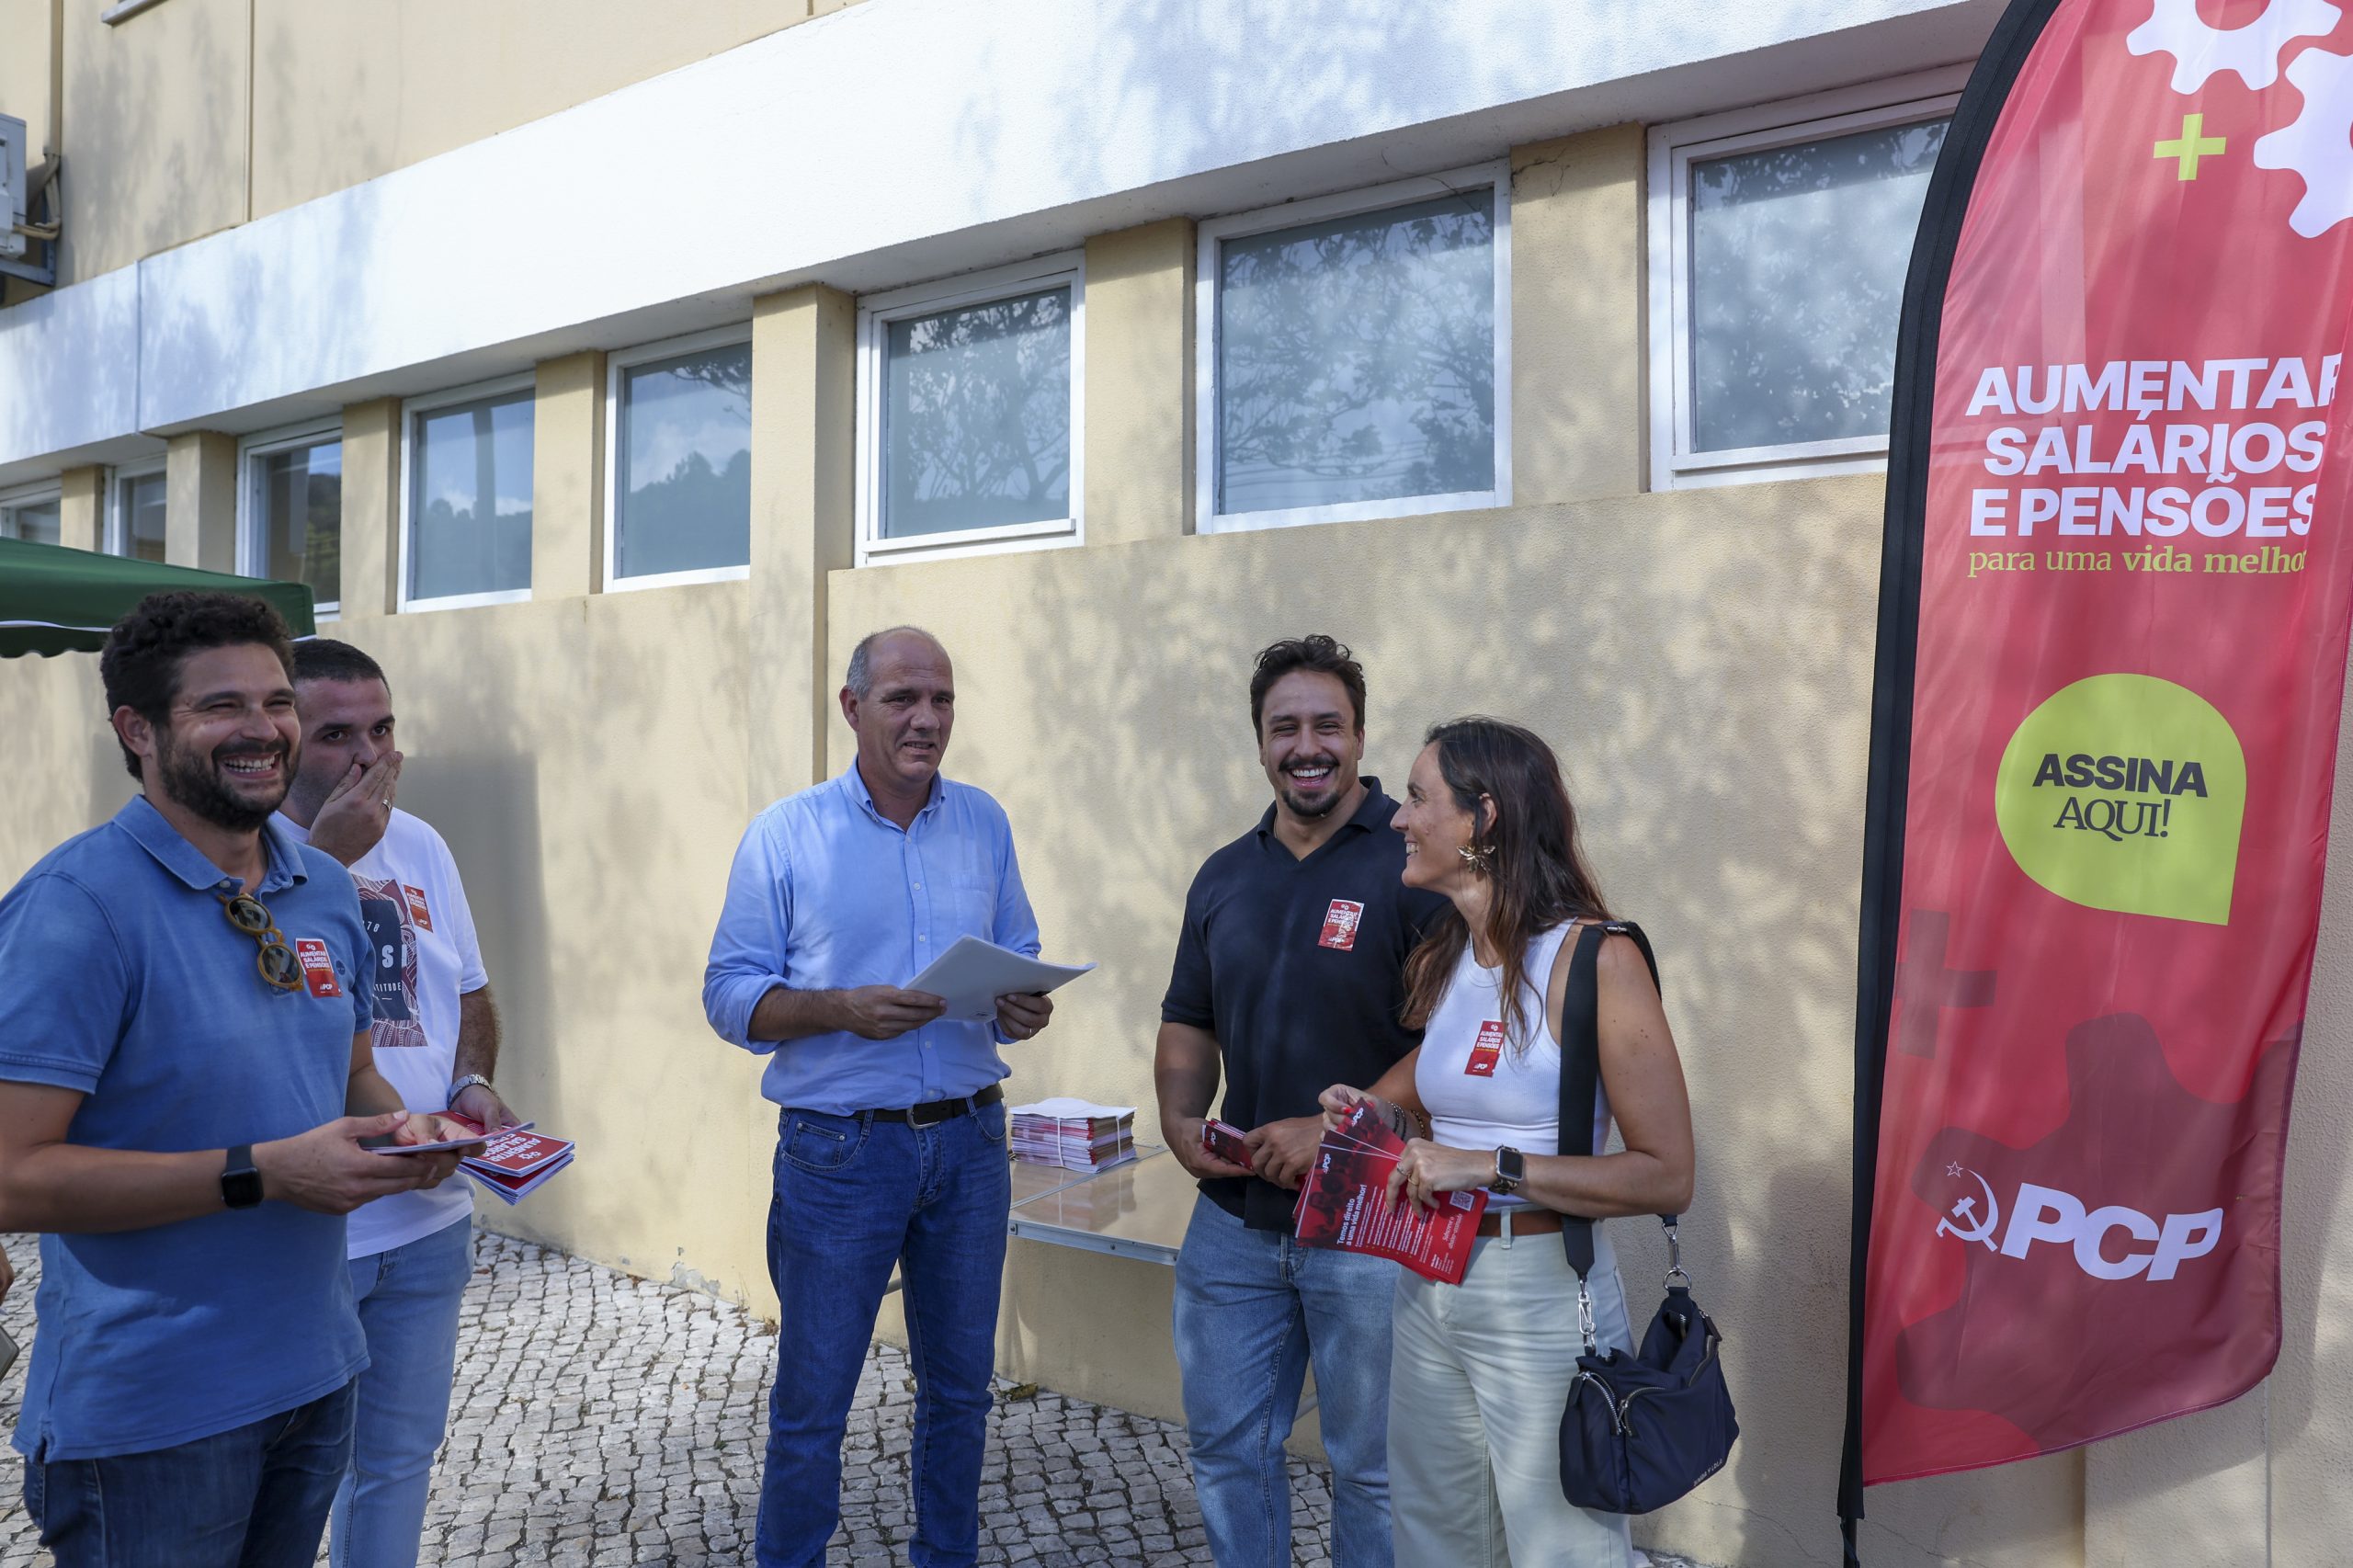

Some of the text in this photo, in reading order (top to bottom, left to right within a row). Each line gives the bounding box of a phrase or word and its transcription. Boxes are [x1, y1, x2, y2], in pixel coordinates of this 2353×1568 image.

[1984, 408, 2327, 476] SALÁRIOS
[1970, 472, 2317, 538] E PENSÕES
[1967, 550, 2036, 577] para
[2046, 550, 2112, 572] uma
[2122, 545, 2193, 573] vida
[2032, 753, 2208, 798] ASSINA
[2052, 796, 2171, 841] AQUI!
[1350, 1210, 1360, 1225] vida
[1356, 1184, 1367, 1210] melhor!
[1336, 1198, 1356, 1245] Temos direito
[1347, 1225, 1356, 1241] uma
[2000, 1182, 2223, 1281] PCP
